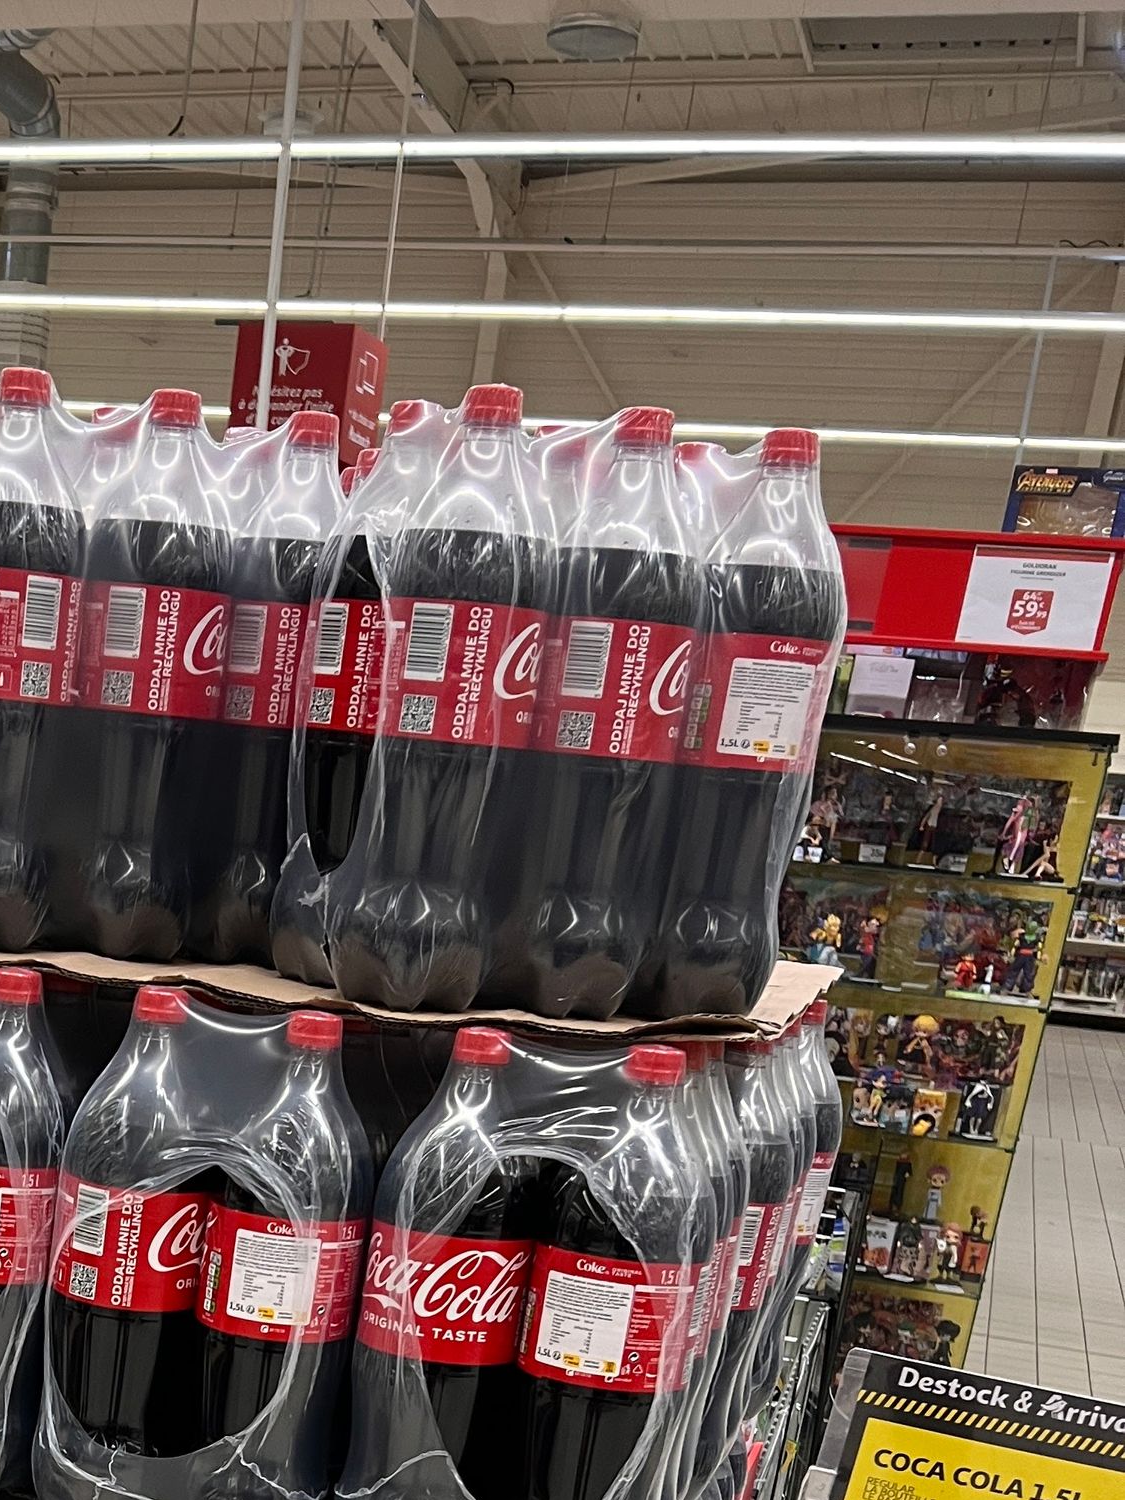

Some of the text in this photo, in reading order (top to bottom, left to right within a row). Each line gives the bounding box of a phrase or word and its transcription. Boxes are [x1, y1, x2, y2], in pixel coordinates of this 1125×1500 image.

[302, 387, 323, 400] pas
[162, 591, 181, 679] RECYKLINGU
[1012, 600, 1038, 618] 59
[148, 590, 171, 711] ODDAJ MNIE DO
[451, 606, 482, 738] ODDAJ MNIE DO
[469, 608, 493, 702] RECYKLINGU
[628, 626, 651, 718] RECYKLINGU
[770, 640, 799, 654] Coke
[609, 624, 640, 753] ODDAJ MNIE DO
[111, 1192, 134, 1306] ODDAJ MNIE DO
[126, 1194, 144, 1276] RECYKLINGU
[267, 1221, 294, 1235] Coke
[576, 1258, 605, 1275] Coke
[363, 1309, 487, 1344] ORIGINAL TASTE
[897, 1366, 1125, 1433] Destock & Arriva
[864, 1484, 877, 1495] LA
[866, 1476, 915, 1494] REGULAR
[873, 1448, 946, 1482] COCA
[953, 1466, 1024, 1498] COLA
